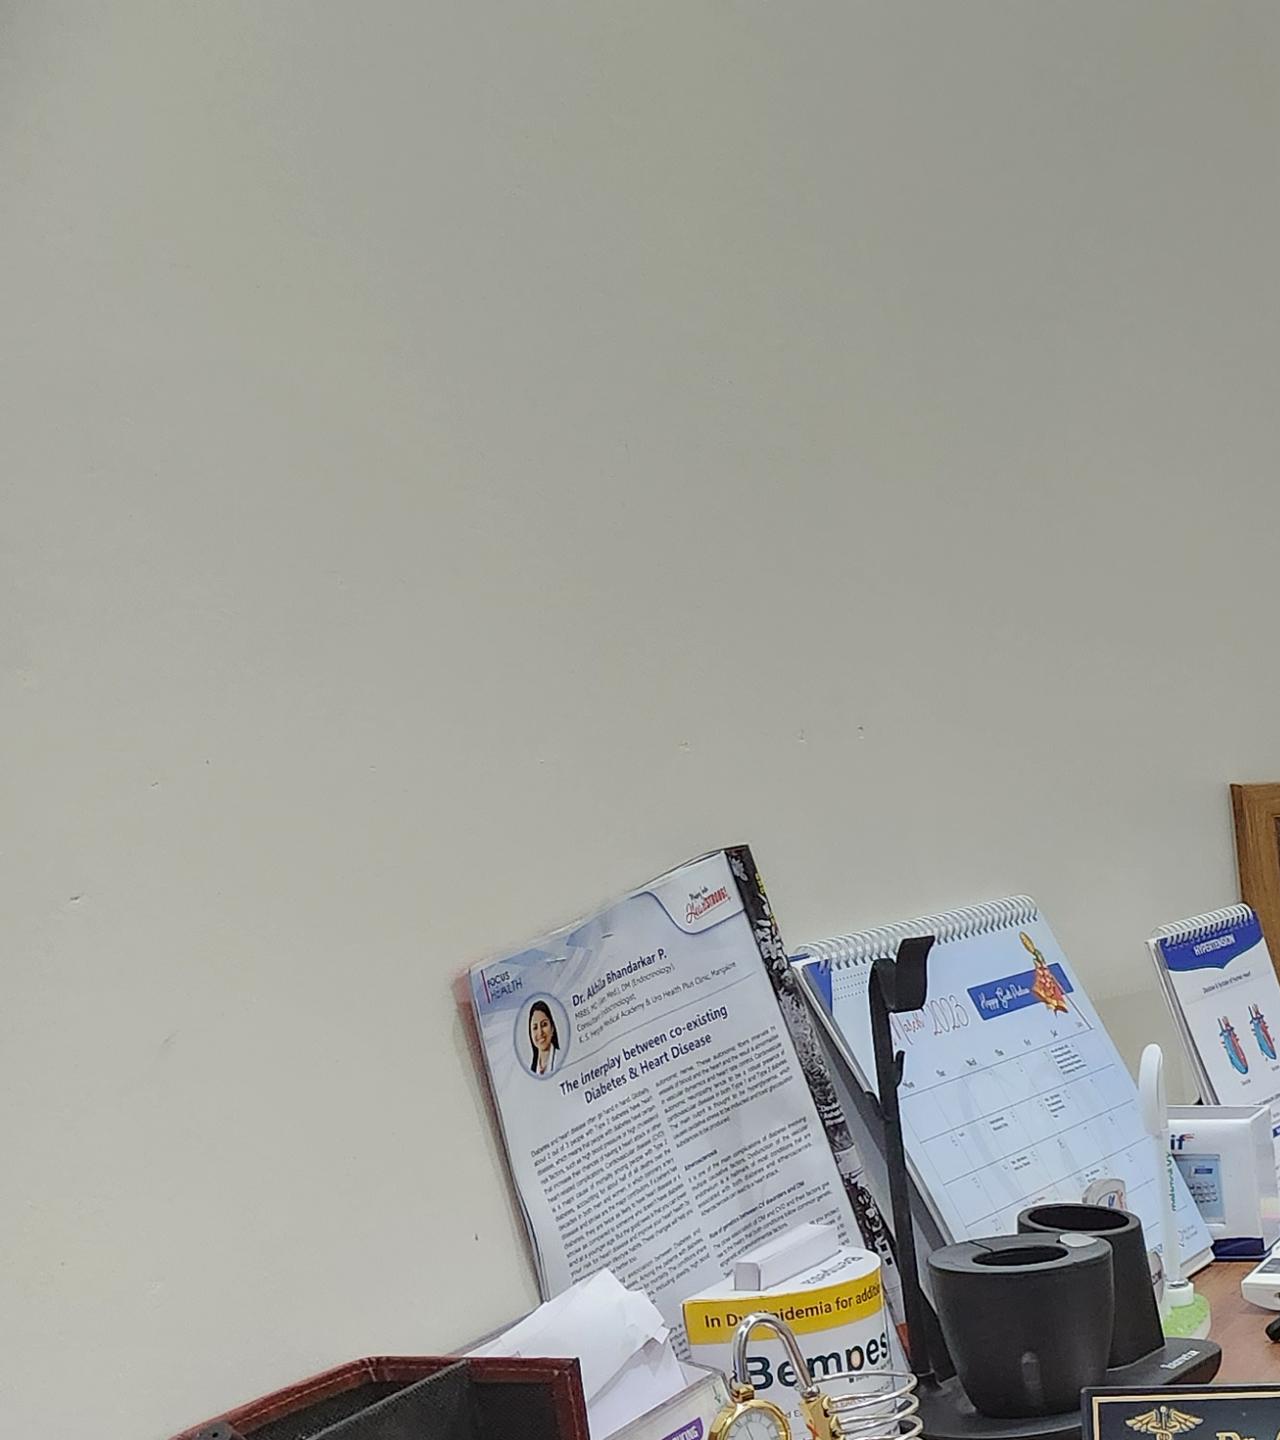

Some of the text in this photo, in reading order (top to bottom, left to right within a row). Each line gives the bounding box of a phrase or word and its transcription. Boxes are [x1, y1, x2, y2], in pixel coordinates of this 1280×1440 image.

[572, 994, 586, 1007] Dr.
[657, 948, 667, 960] P.
[558, 1005, 728, 1096] The interplay between co-existing
[584, 1033, 712, 1104] Diabetes & Heart Disease
[705, 1315, 721, 1328] In
[836, 1297, 852, 1310] for
